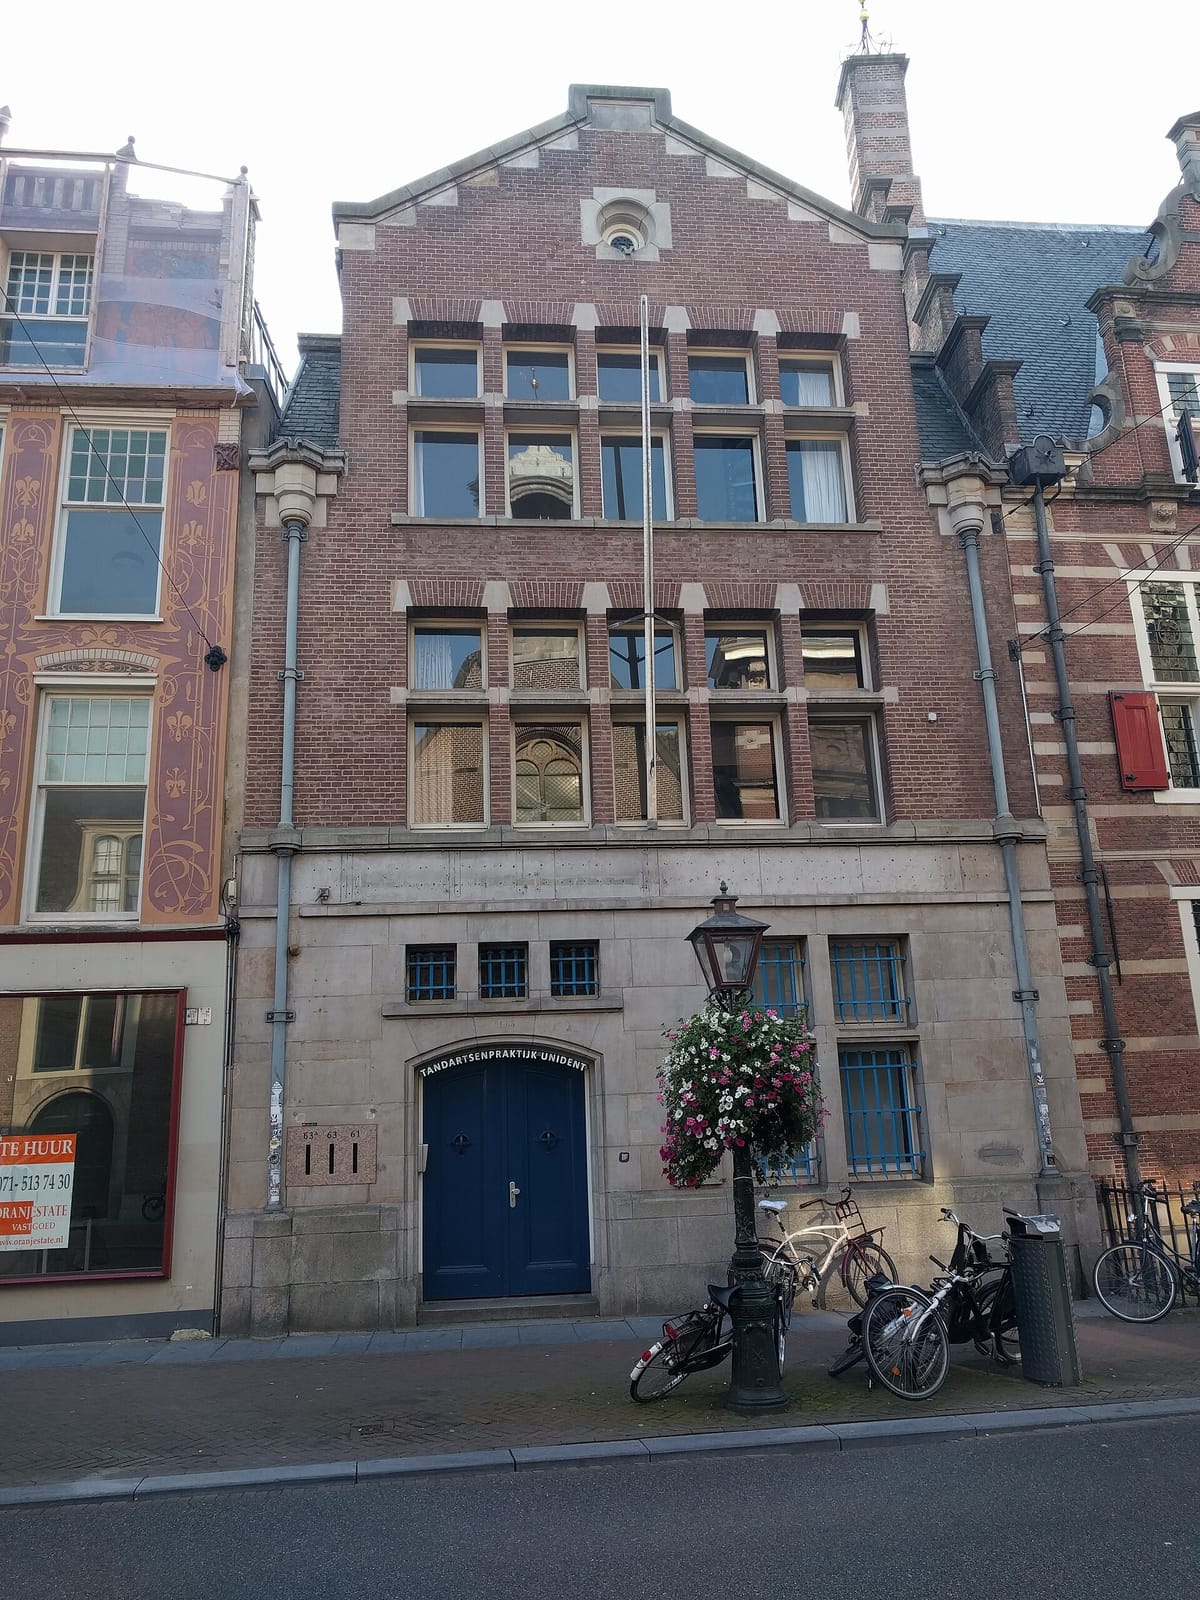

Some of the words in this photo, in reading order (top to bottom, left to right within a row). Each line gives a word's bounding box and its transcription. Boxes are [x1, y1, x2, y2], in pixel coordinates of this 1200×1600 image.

[420, 1049, 537, 1077] TANDARTSENPRAKTIJK
[541, 1052, 587, 1072] UNIDENT
[327, 1131, 337, 1139] 63
[350, 1130, 360, 1138] 61
[0, 1142, 20, 1157] TE
[23, 1139, 73, 1156] HUUR
[21, 1175, 40, 1191] 513
[43, 1174, 55, 1190] 74
[57, 1173, 71, 1190] 30
[12, 1221, 56, 1231] VASTGOED
